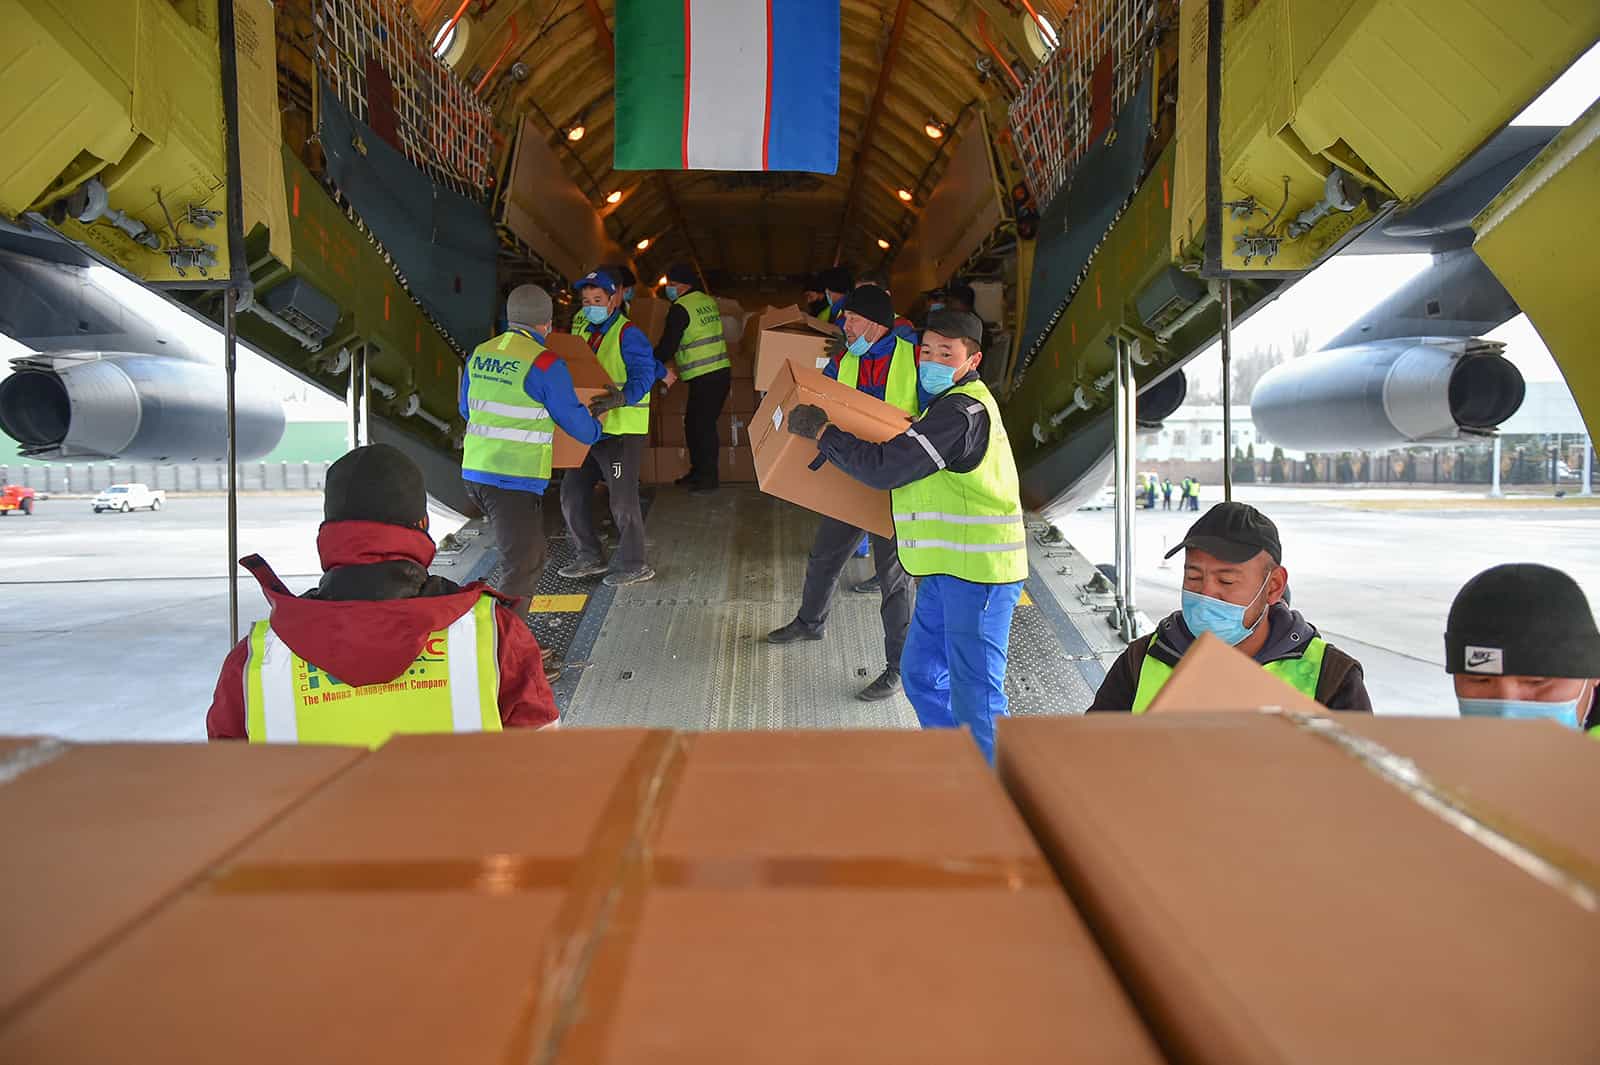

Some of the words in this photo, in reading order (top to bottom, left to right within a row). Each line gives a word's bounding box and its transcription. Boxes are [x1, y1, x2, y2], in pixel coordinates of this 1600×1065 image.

[303, 695, 320, 706] The
[322, 690, 352, 703] Manas
[355, 681, 408, 697] Management
[411, 679, 448, 690] Company
